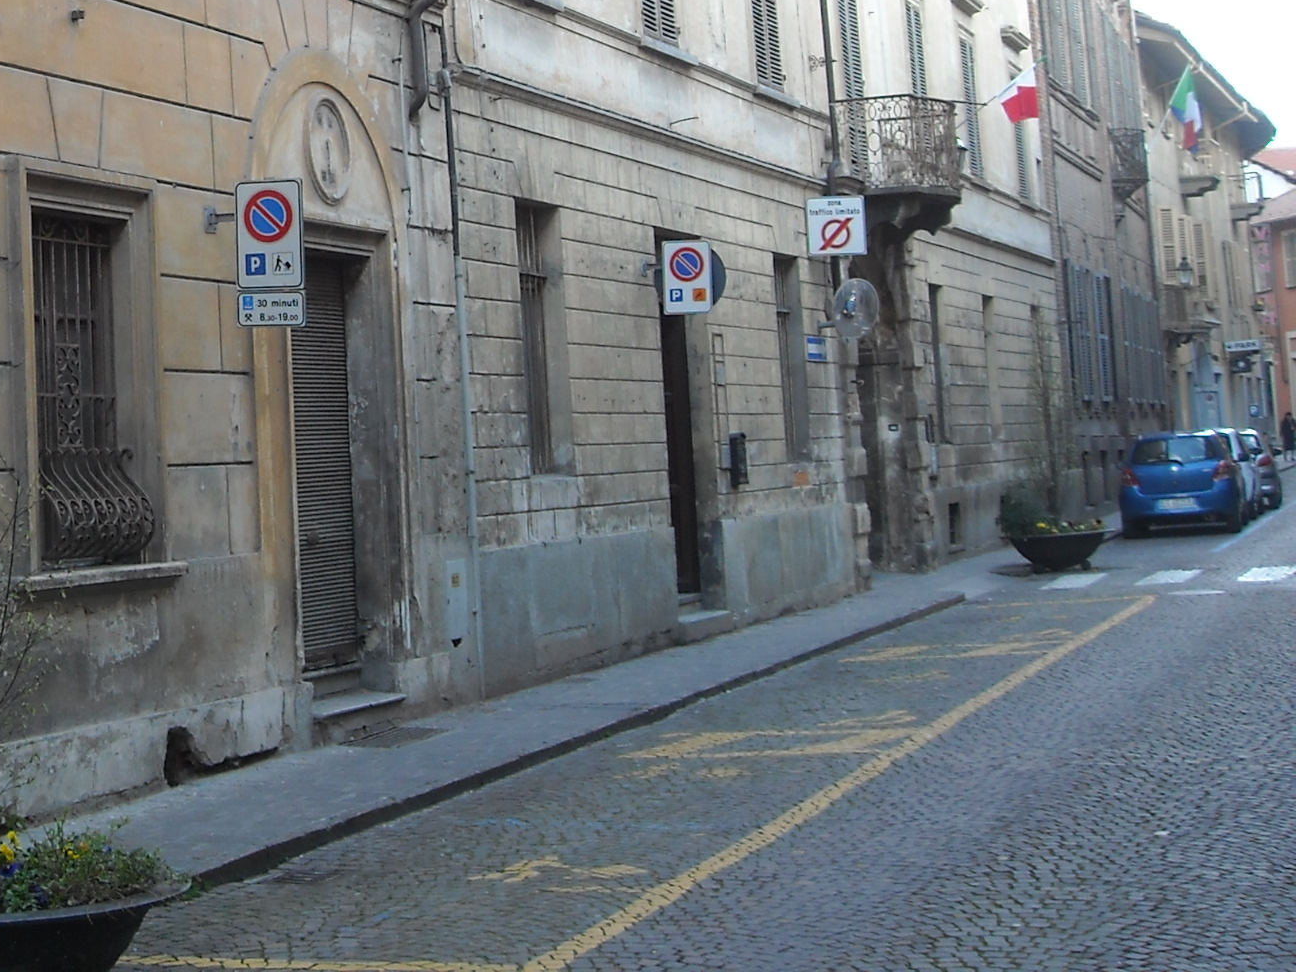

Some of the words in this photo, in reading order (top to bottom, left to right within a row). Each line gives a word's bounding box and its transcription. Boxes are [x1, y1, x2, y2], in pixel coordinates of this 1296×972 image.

[836, 208, 861, 216] limitato
[257, 299, 268, 308] 30
[271, 299, 299, 308] minuti
